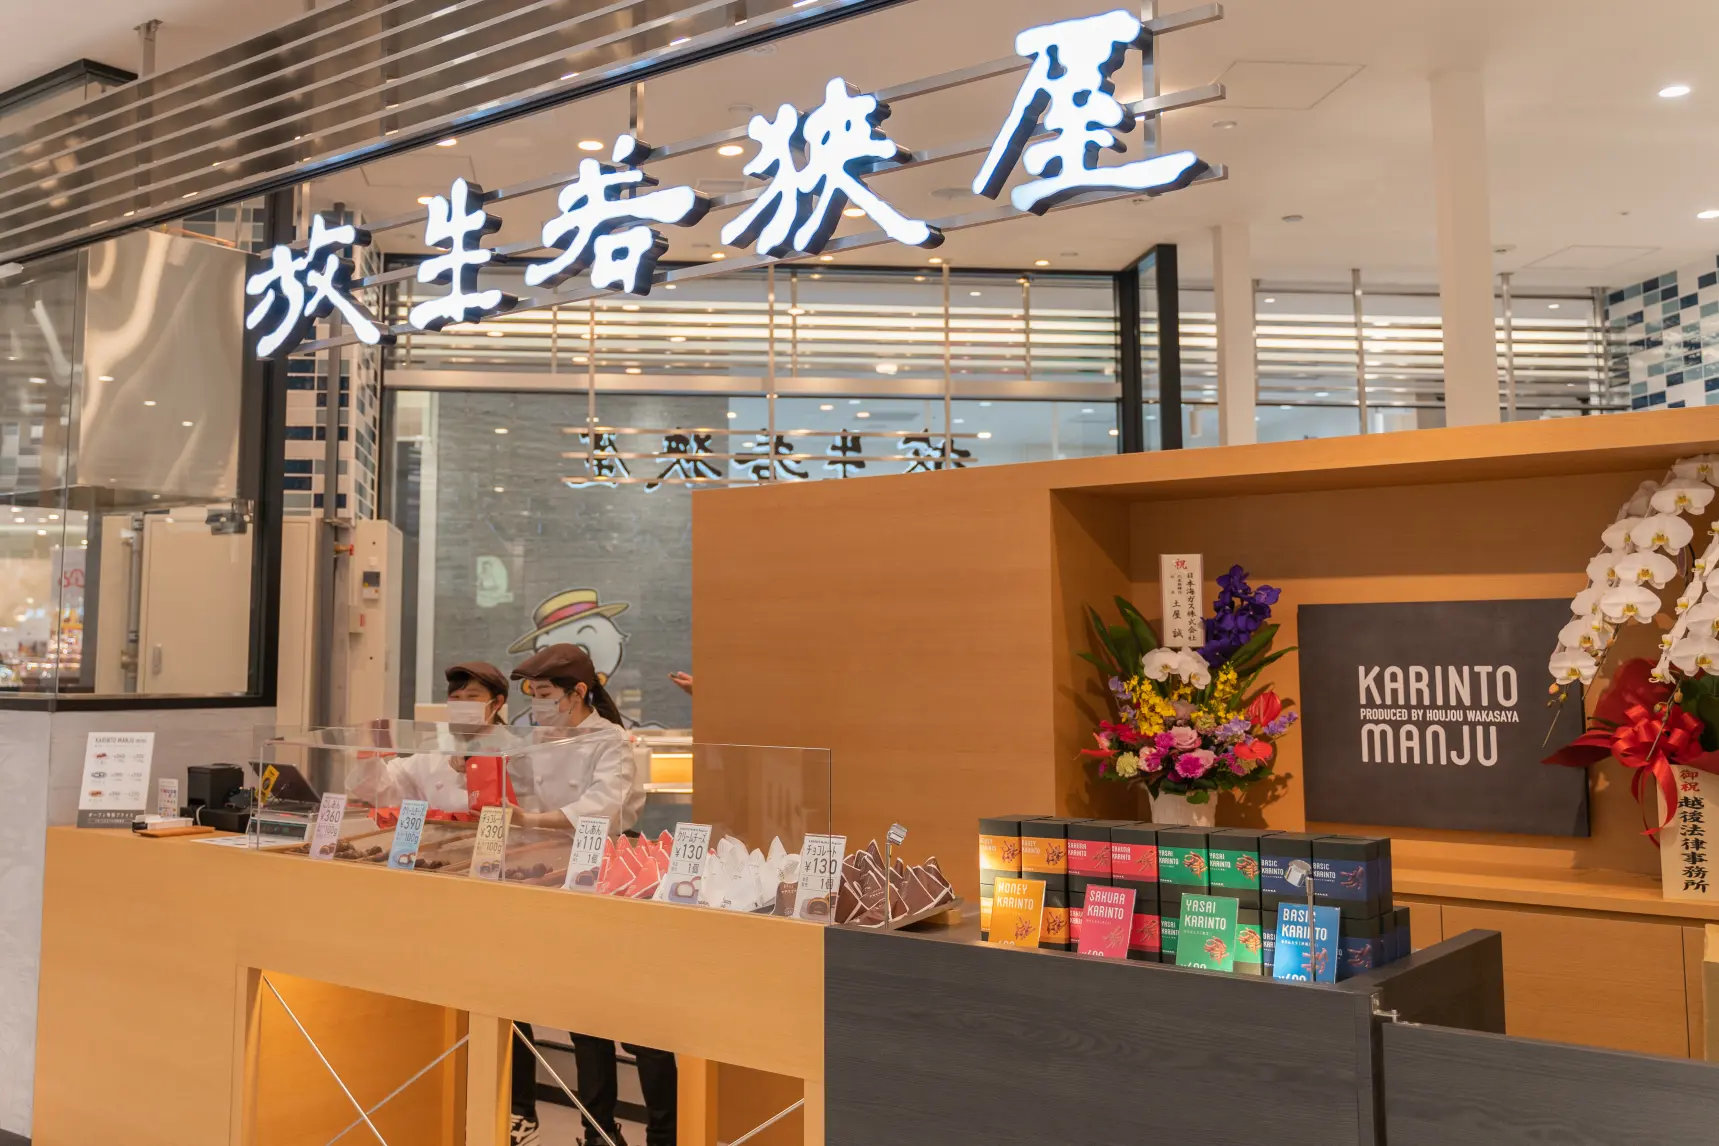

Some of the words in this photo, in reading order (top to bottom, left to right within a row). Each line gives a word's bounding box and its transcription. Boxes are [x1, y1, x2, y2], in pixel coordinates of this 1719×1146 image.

[1174, 558, 1188, 570] 祝
[1185, 572, 1198, 641] 日本海ガス株式会社
[1358, 664, 1518, 707] KARINTO
[1360, 708, 1408, 721] PRODUCED
[1411, 709, 1423, 721] BY
[1426, 709, 1463, 722] HOUJOU
[1466, 710, 1519, 723] WAKASAYA
[1361, 723, 1498, 767] MANJU
[1679, 770, 1700, 792] 御祝
[320, 810, 341, 823] ¥360
[400, 817, 422, 831] ¥390
[579, 825, 602, 836] こしあん
[405, 832, 419, 845] 100g
[480, 825, 504, 839] ¥390
[677, 831, 707, 843] クリームチーズ
[486, 842, 502, 855] 100g
[576, 836, 602, 851] ¥110
[1678, 796, 1710, 893] 越後法律事務所
[675, 844, 703, 860] ¥130
[807, 845, 837, 857] チョコレート
[587, 853, 599, 864] 1個
[688, 863, 699, 874] 1個
[805, 858, 838, 875] ¥130
[1261, 867, 1284, 876] KARINTO
[1313, 862, 1330, 870] BASIC
[1313, 870, 1336, 879] KARINTO
[998, 881, 1028, 895] HONEY
[996, 895, 1034, 910] KARINTO
[1089, 890, 1126, 905] SAKURA
[1087, 904, 1124, 920] KARINTO
[1186, 899, 1216, 914] YASAI
[1184, 914, 1227, 931] KARINTO
[1161, 928, 1180, 936] KARINT
[1263, 932, 1276, 940] BASI
[1263, 940, 1276, 948] KARI
